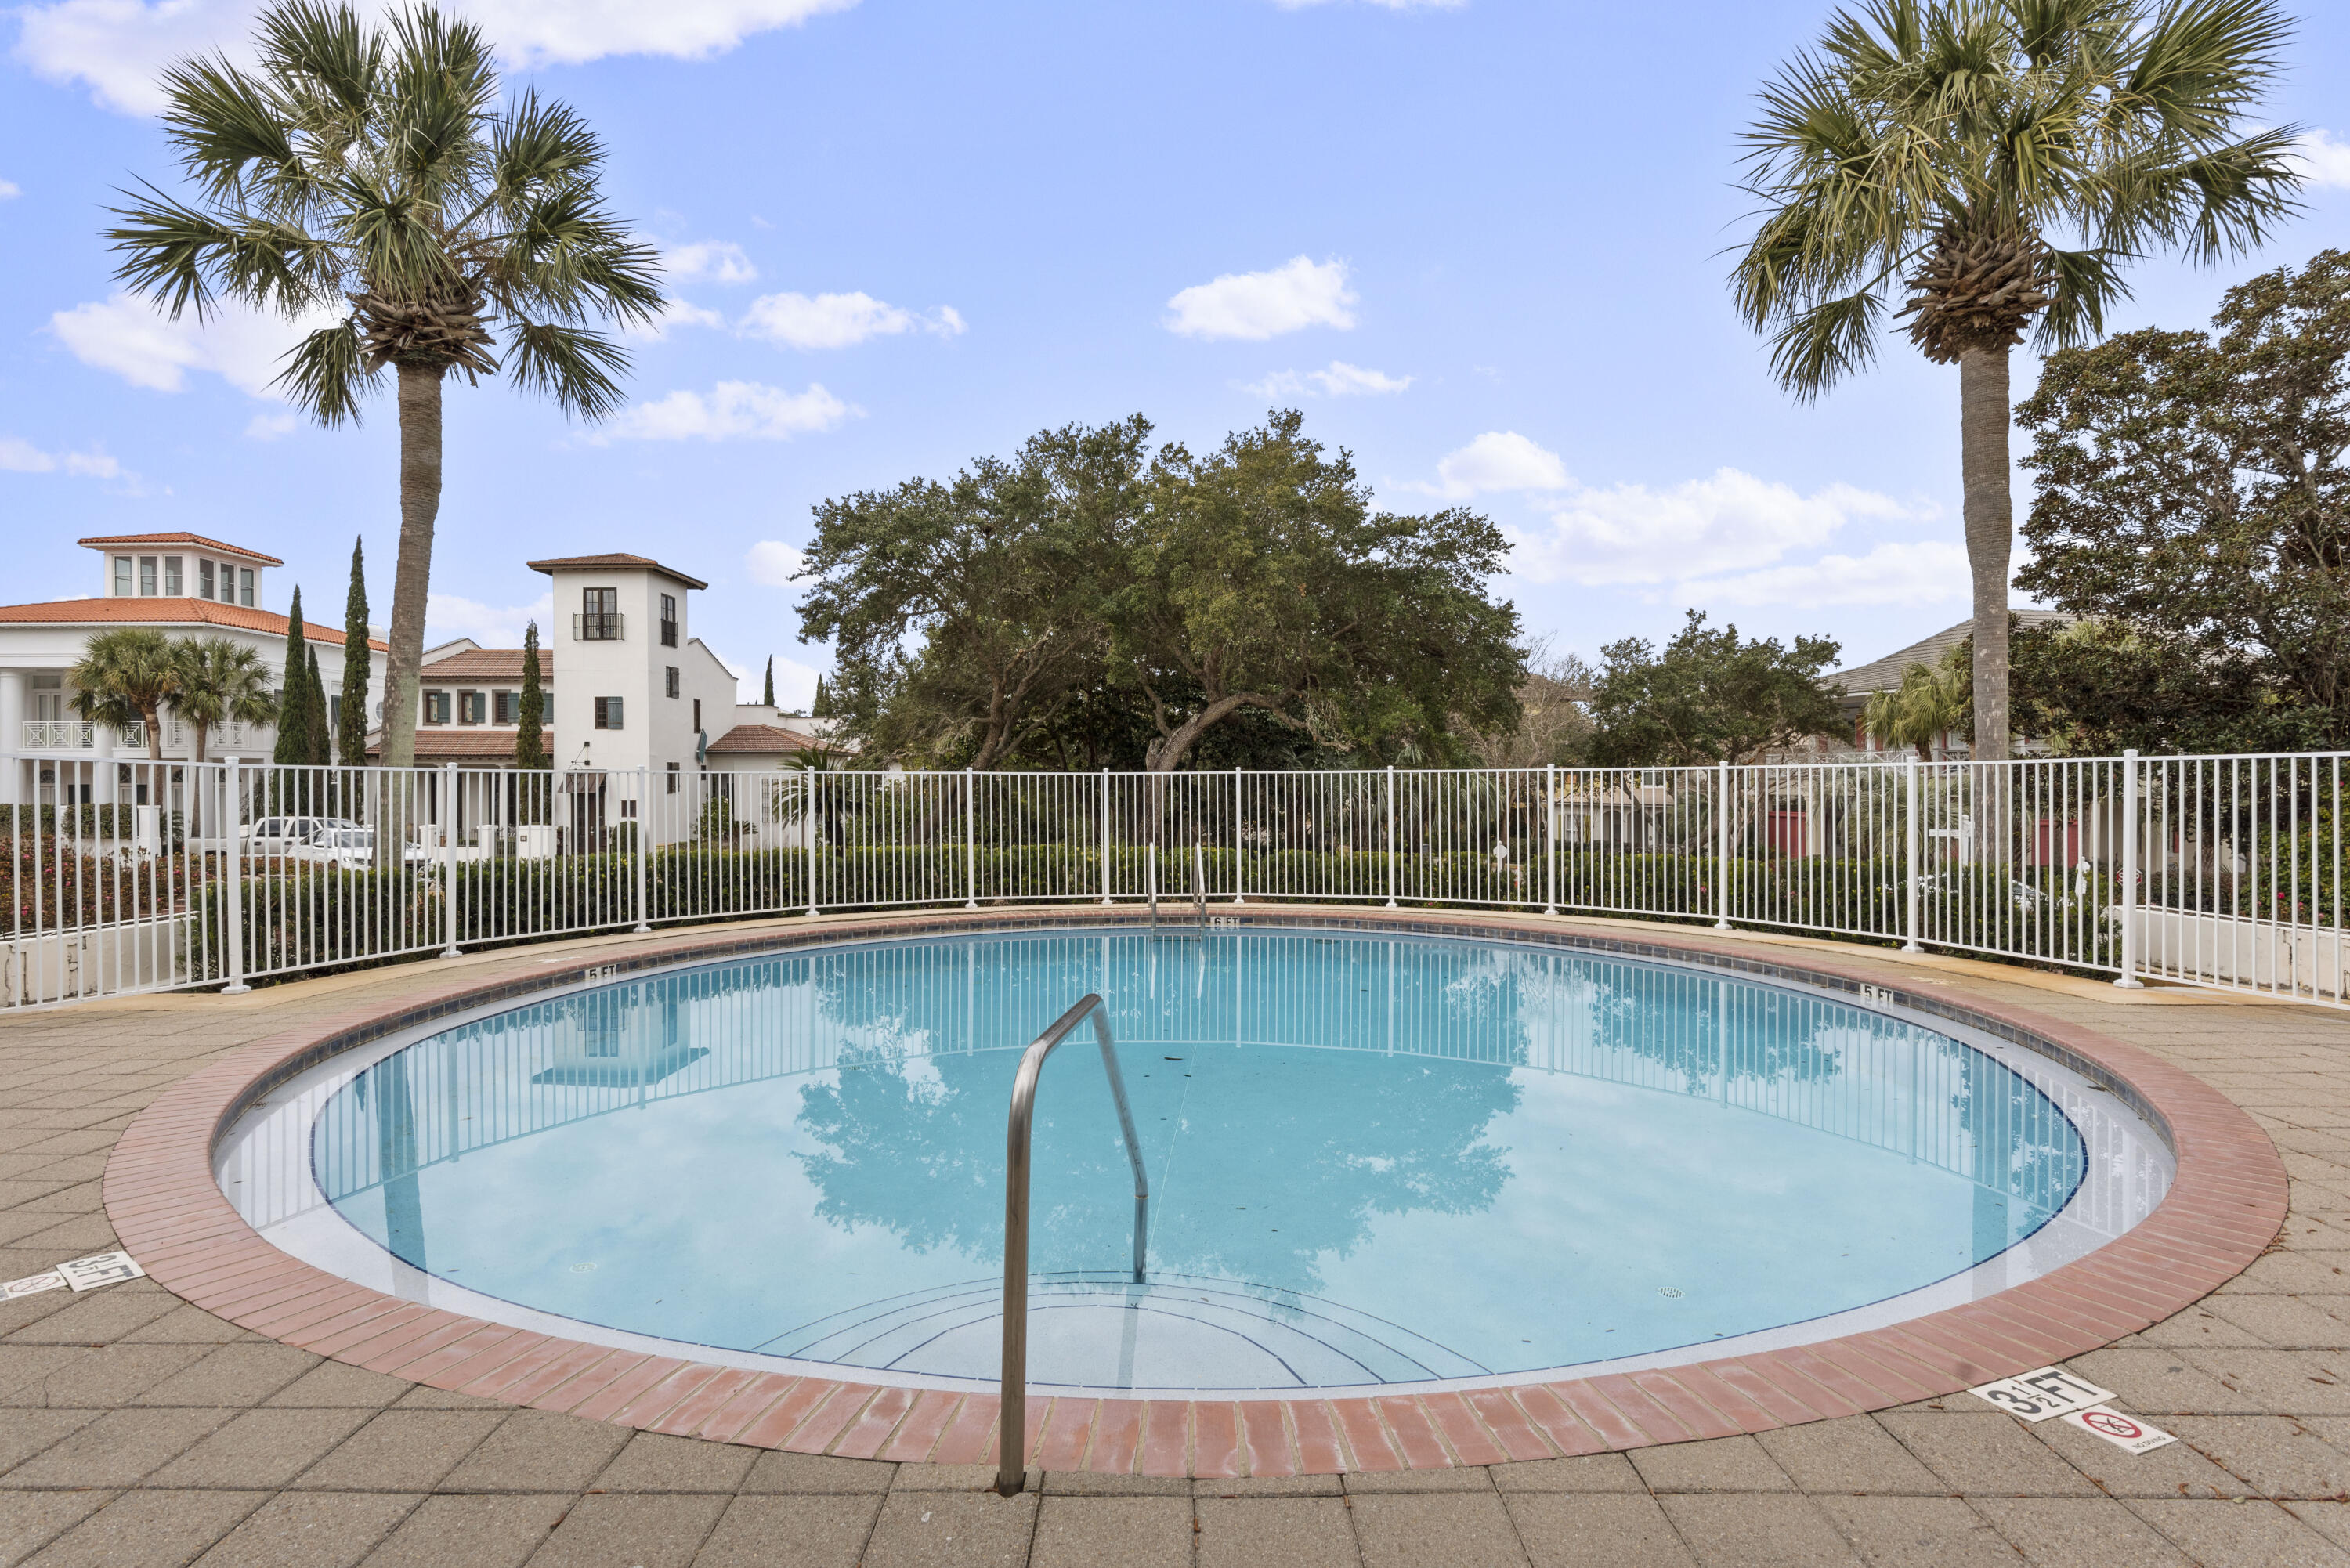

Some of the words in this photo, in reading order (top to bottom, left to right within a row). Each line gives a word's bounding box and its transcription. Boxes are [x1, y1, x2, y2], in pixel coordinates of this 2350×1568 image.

[2118, 872, 2140, 882] SP
[1214, 917, 1222, 926] 6
[589, 968, 597, 978] 5
[602, 965, 615, 977] FT
[1864, 985, 1873, 997] 5
[1878, 988, 1892, 1002] FT
[77, 1264, 135, 1286] FT
[2023, 1371, 2099, 1404] FT
